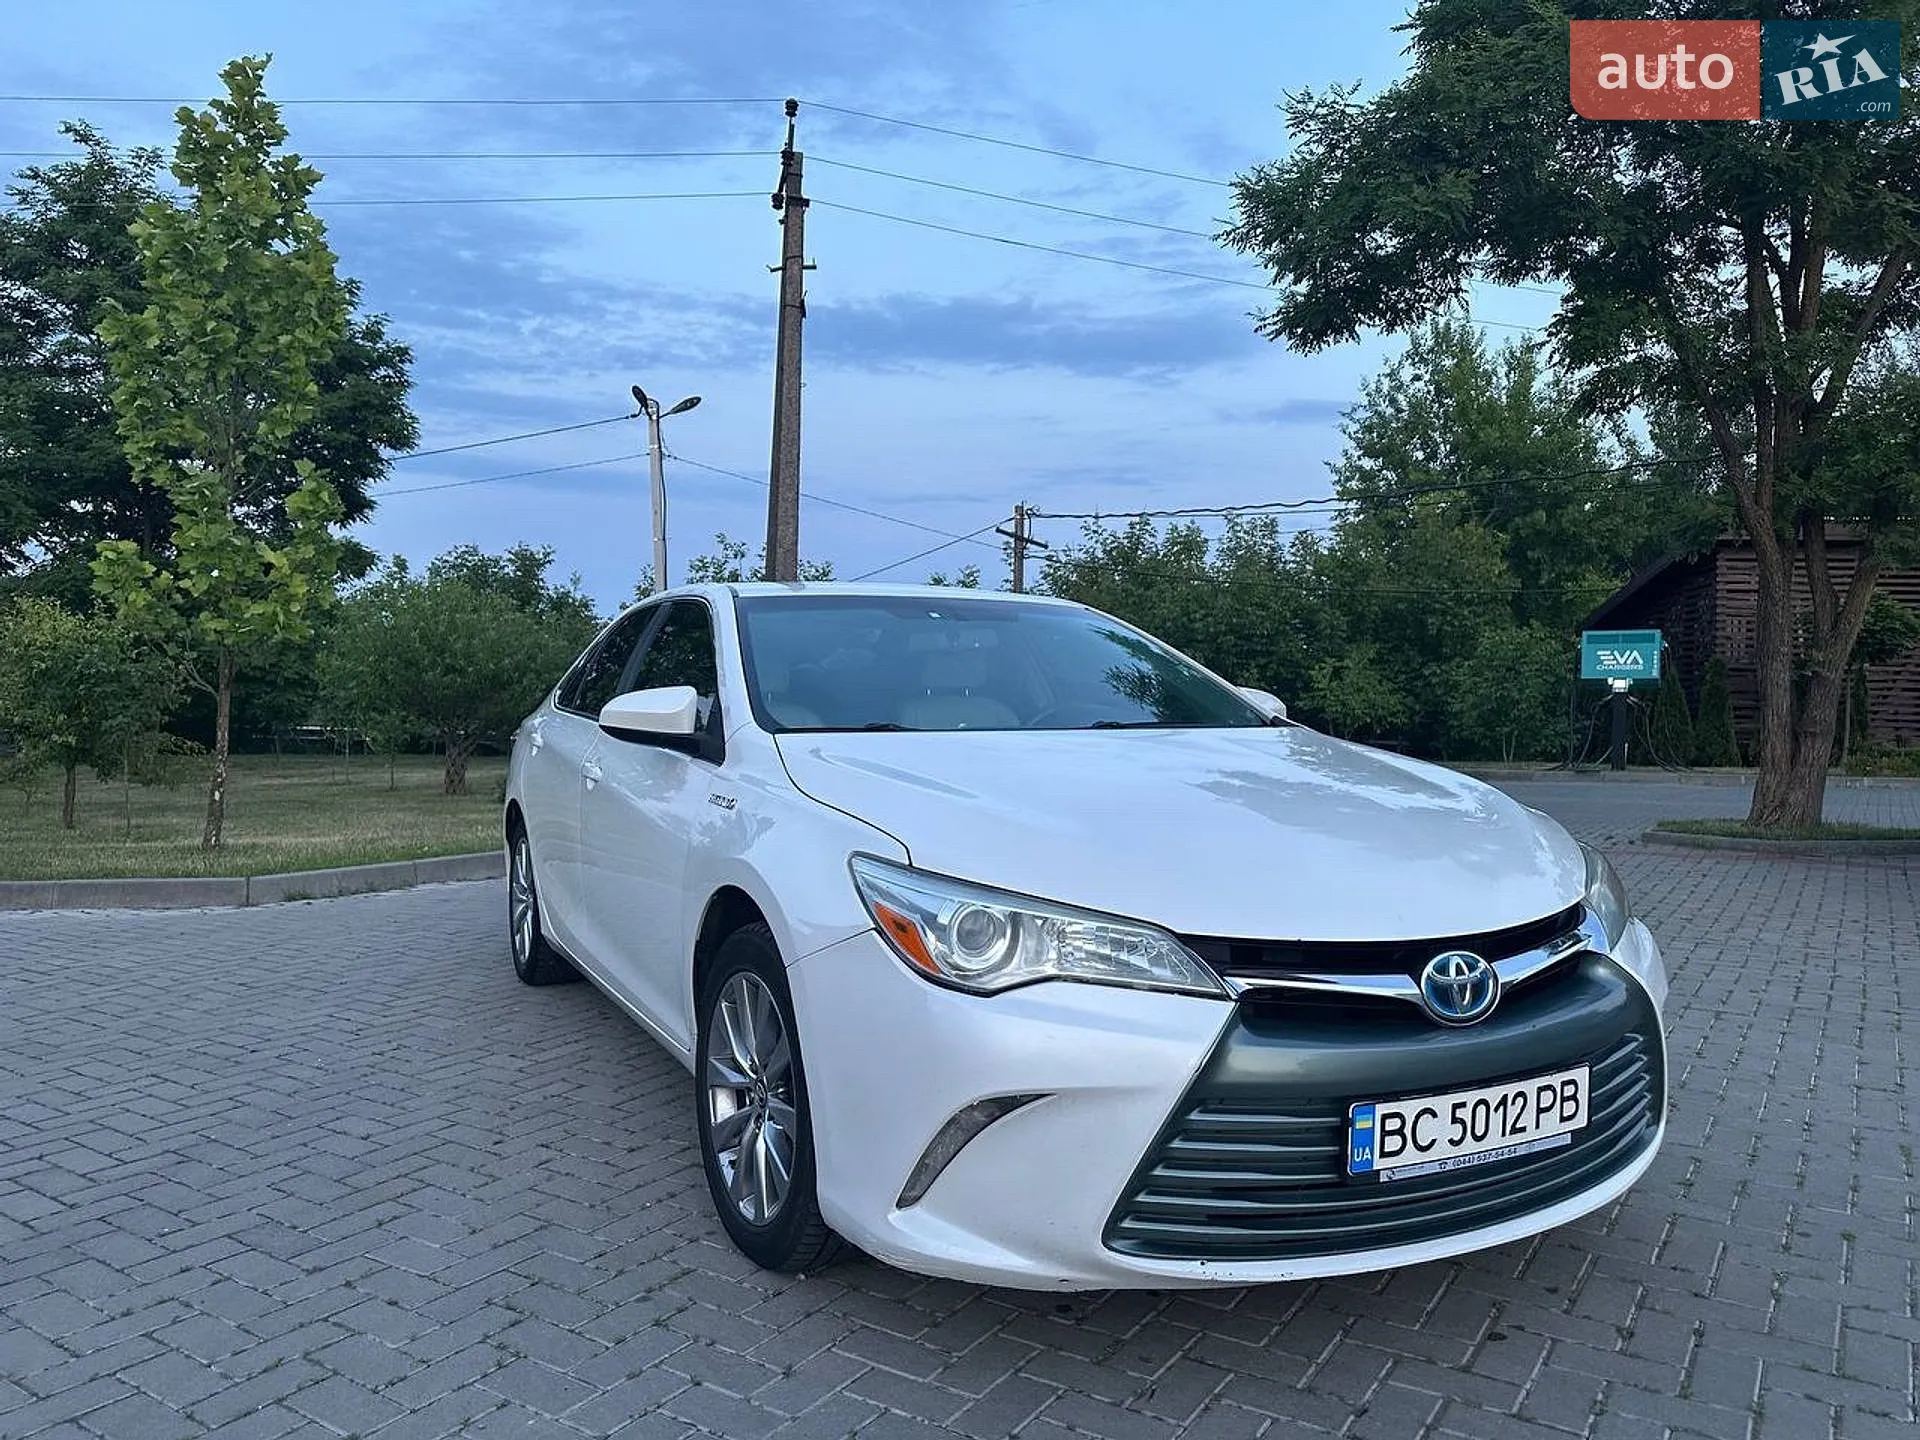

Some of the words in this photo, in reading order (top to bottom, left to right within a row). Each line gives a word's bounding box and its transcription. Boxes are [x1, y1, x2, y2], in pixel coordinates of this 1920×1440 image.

[1596, 650, 1644, 665] EVA
[1379, 1107, 1438, 1159] BC
[1448, 1091, 1528, 1147] 5012
[1535, 1078, 1579, 1130] PB
[1354, 1147, 1371, 1161] UA
